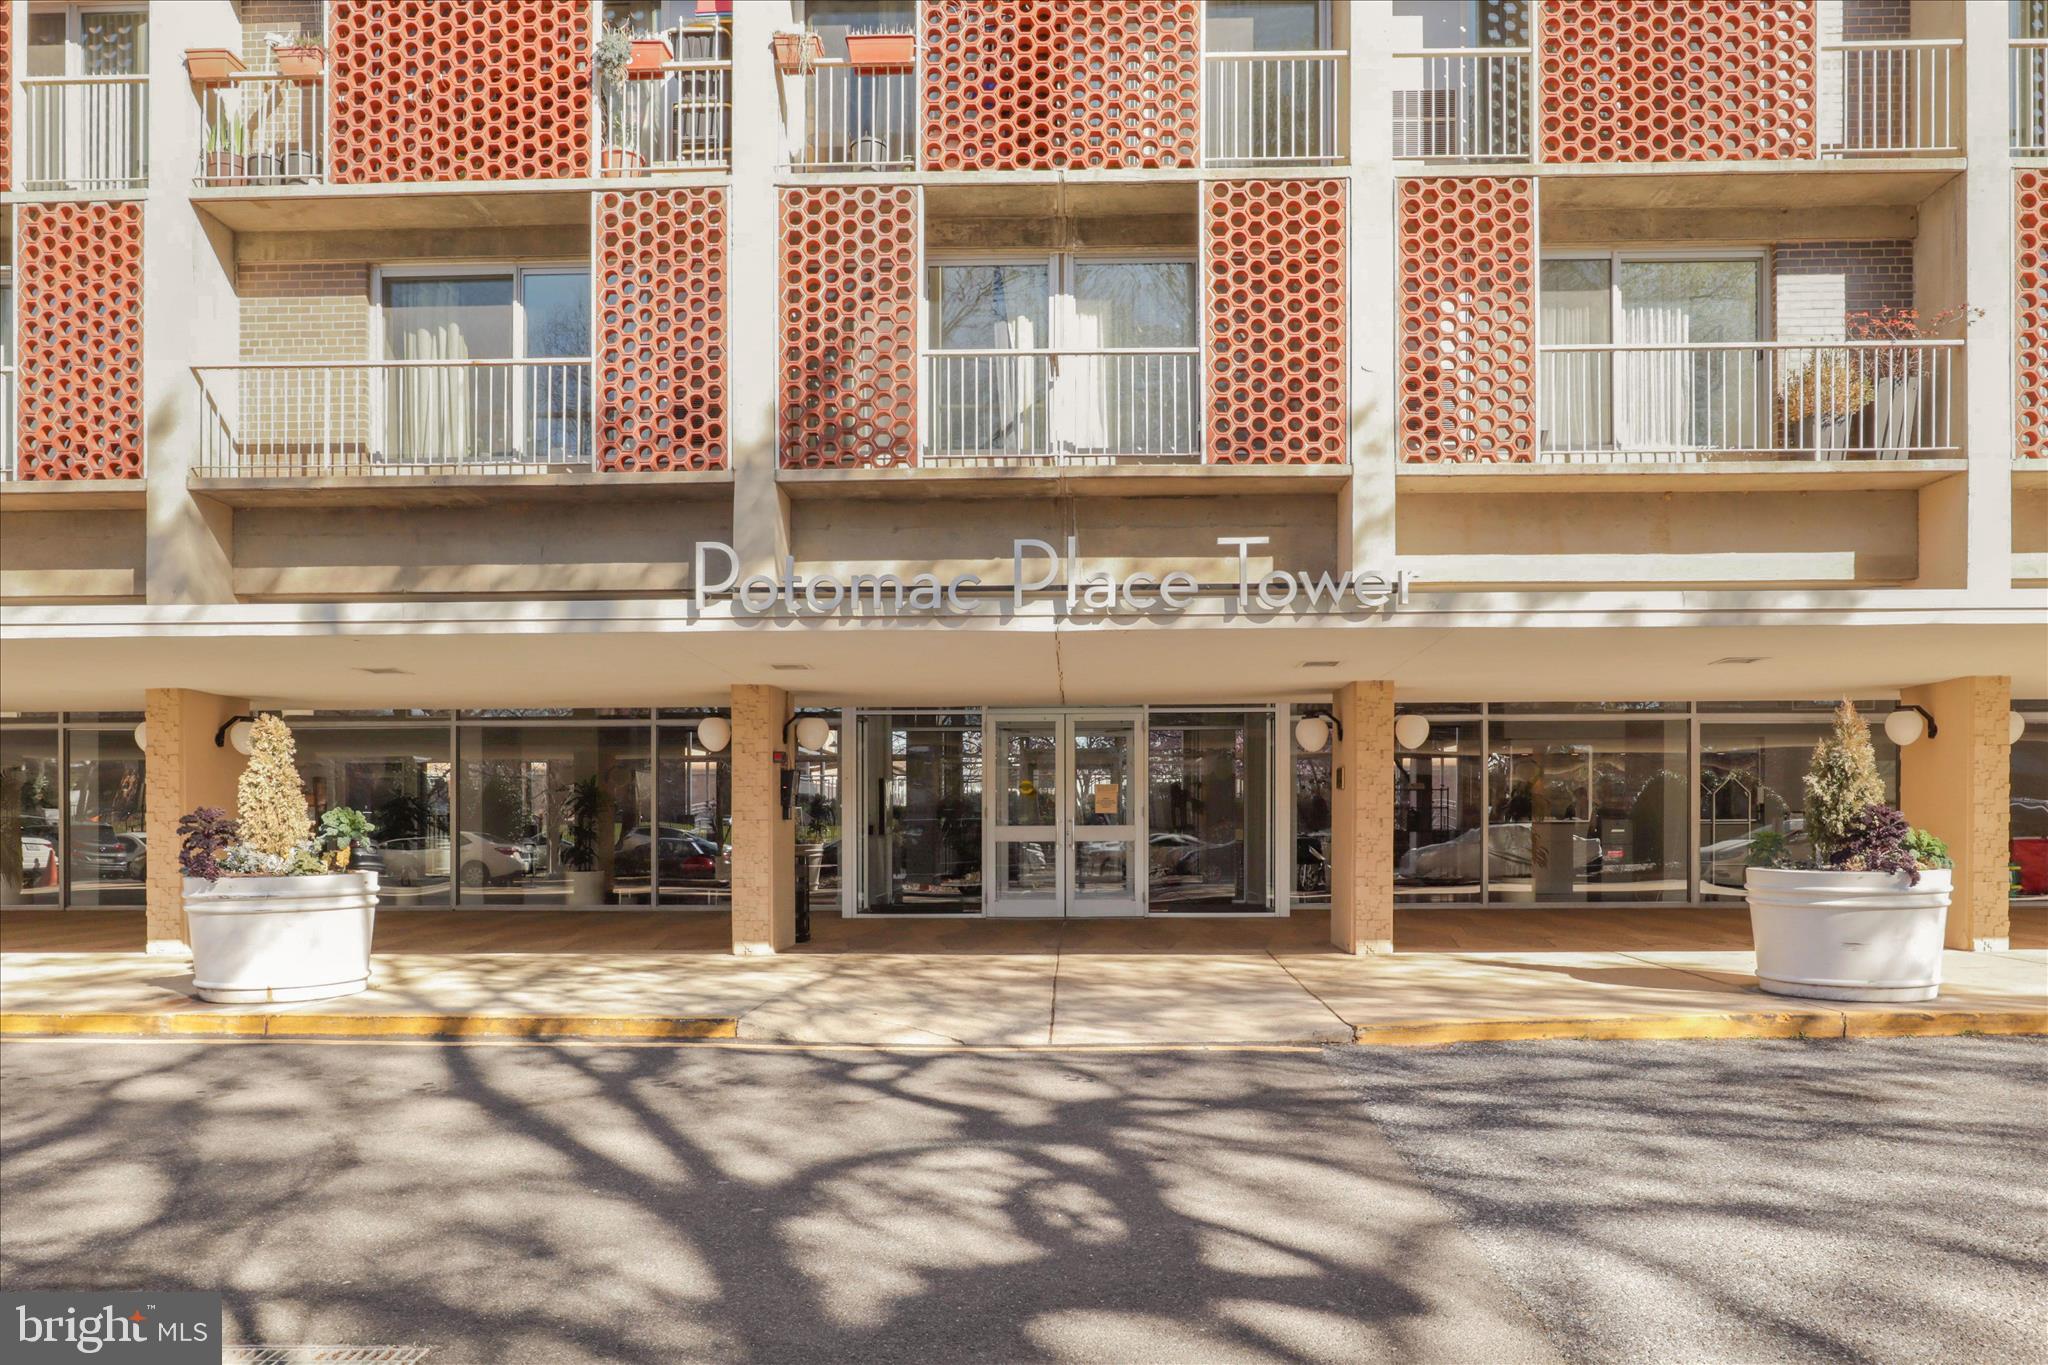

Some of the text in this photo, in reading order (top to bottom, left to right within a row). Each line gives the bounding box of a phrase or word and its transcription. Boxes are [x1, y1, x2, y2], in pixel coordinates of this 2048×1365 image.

[695, 535, 1419, 612] Potomac Place Tower
